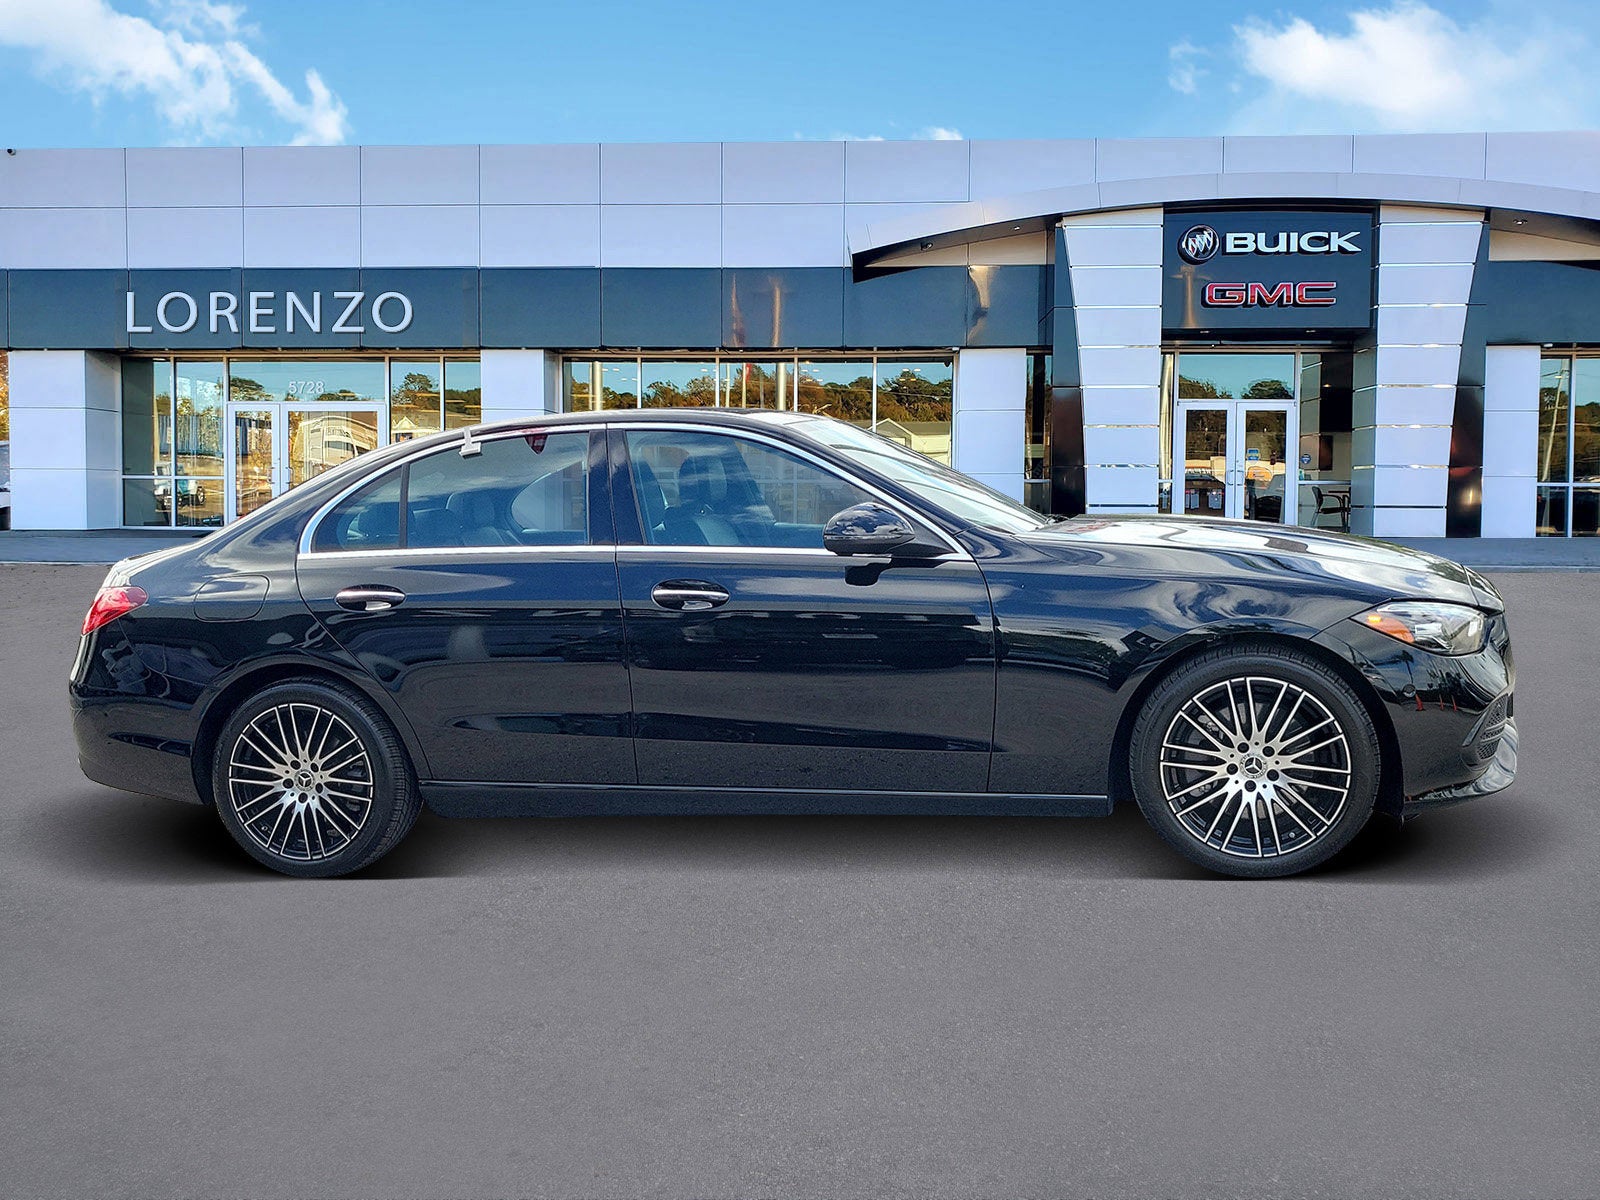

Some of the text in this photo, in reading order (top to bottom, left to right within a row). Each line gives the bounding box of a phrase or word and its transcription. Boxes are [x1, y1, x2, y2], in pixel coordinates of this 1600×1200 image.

[1226, 232, 1361, 253] BUICK
[1206, 282, 1337, 305] GMC
[126, 291, 414, 333] LORENZO
[288, 381, 325, 394] 5728
